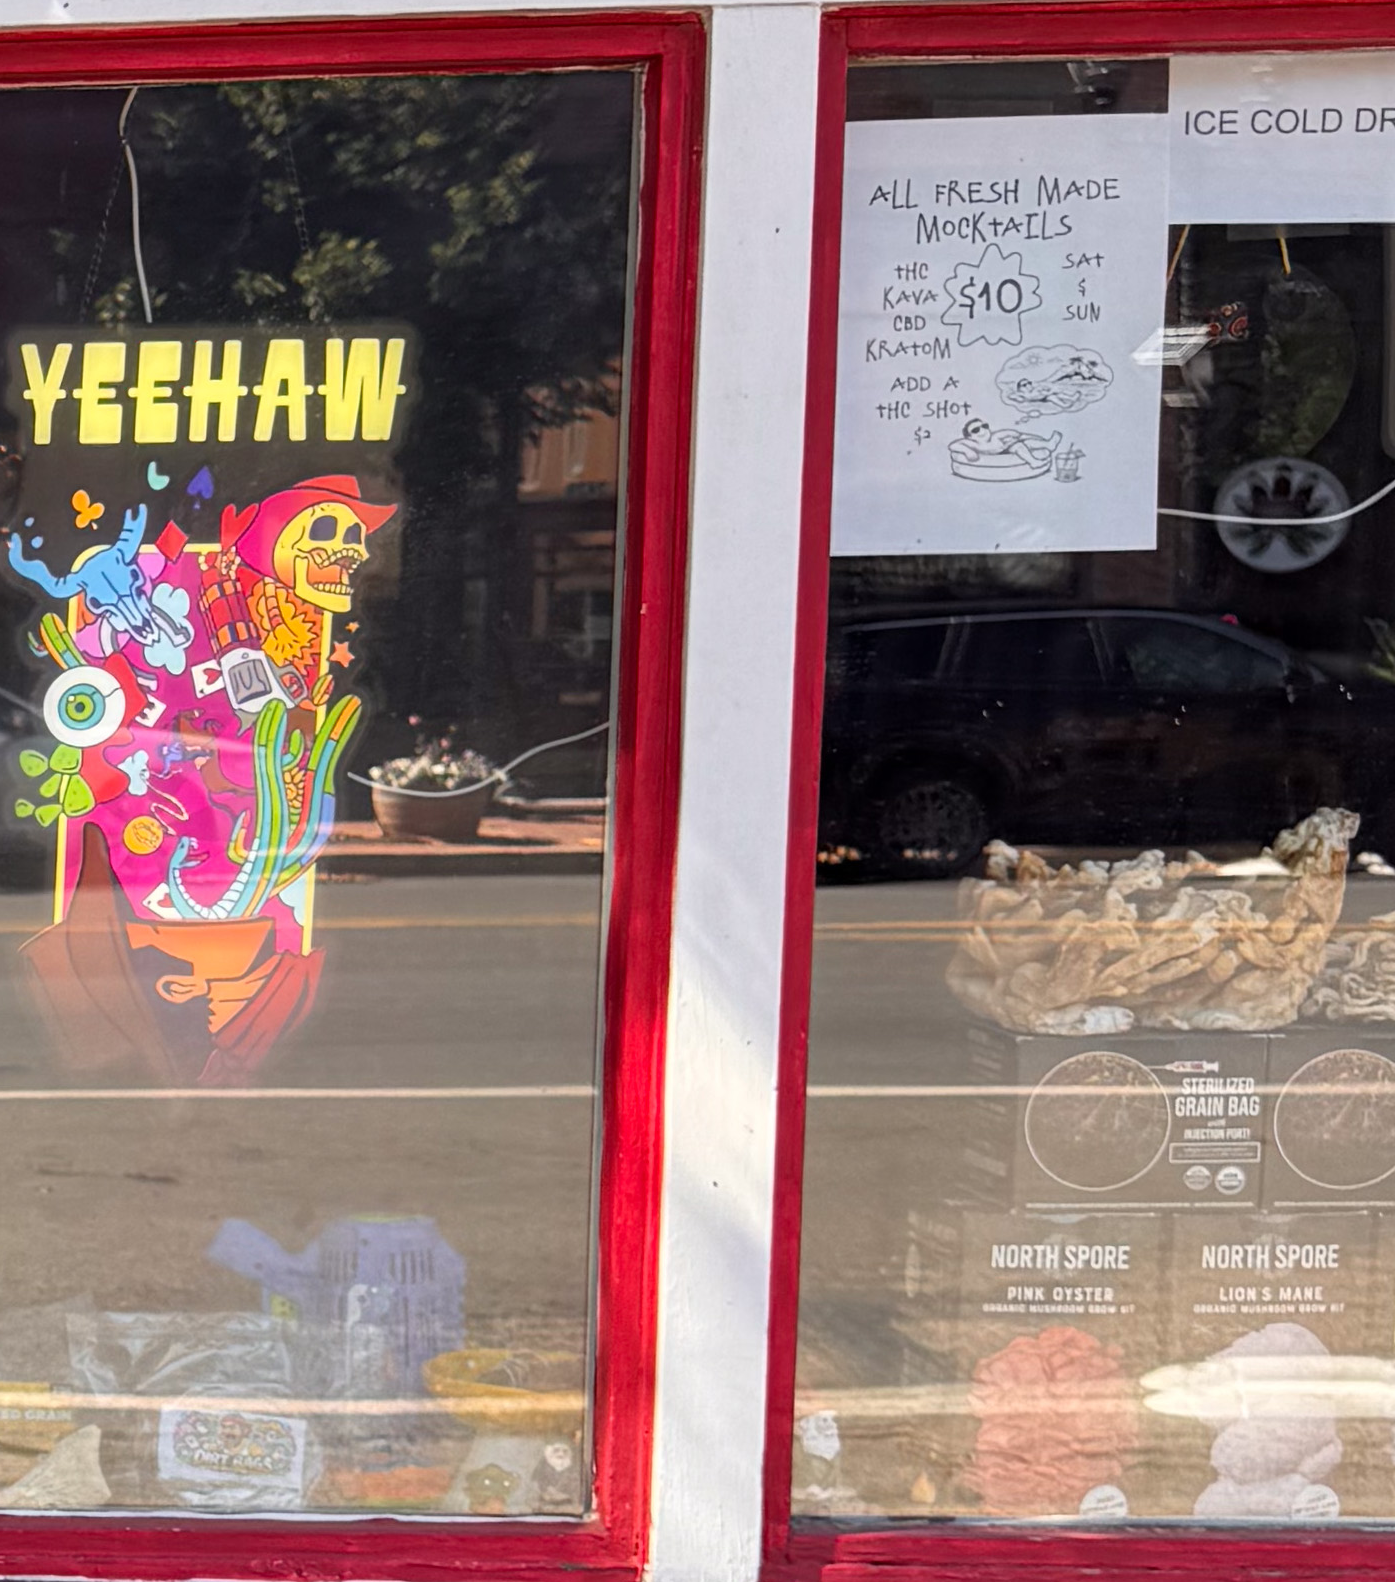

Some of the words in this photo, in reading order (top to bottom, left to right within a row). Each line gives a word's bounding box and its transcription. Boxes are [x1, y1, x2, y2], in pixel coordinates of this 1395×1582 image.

[1185, 110, 1239, 136] ICE
[1250, 108, 1343, 135] COLD
[1355, 107, 1395, 133] DR
[869, 179, 918, 209] ALL
[935, 179, 1020, 207] FRESH
[1037, 175, 1121, 207] MADE
[883, 286, 939, 311] KAVA
[959, 276, 1023, 319] $10
[1062, 302, 1101, 323] SUN
[893, 316, 927, 332] CBD
[21, 337, 407, 446] YEEHAW
[891, 376, 932, 392] ADD
[943, 376, 960, 391] A
[914, 426, 931, 446] $2
[1181, 1077, 1255, 1096] STERILIZED
[1175, 1096, 1224, 1117] GRAIN
[1228, 1095, 1260, 1116] BAG
[991, 1244, 1060, 1268] NORTH
[1063, 1245, 1131, 1269] SPORE
[1201, 1244, 1270, 1269] NORTH
[1274, 1244, 1340, 1268] SPORE
[1007, 1286, 1045, 1301] PINK
[1052, 1286, 1115, 1302] OYSTER
[1279, 1285, 1323, 1301] MANE
